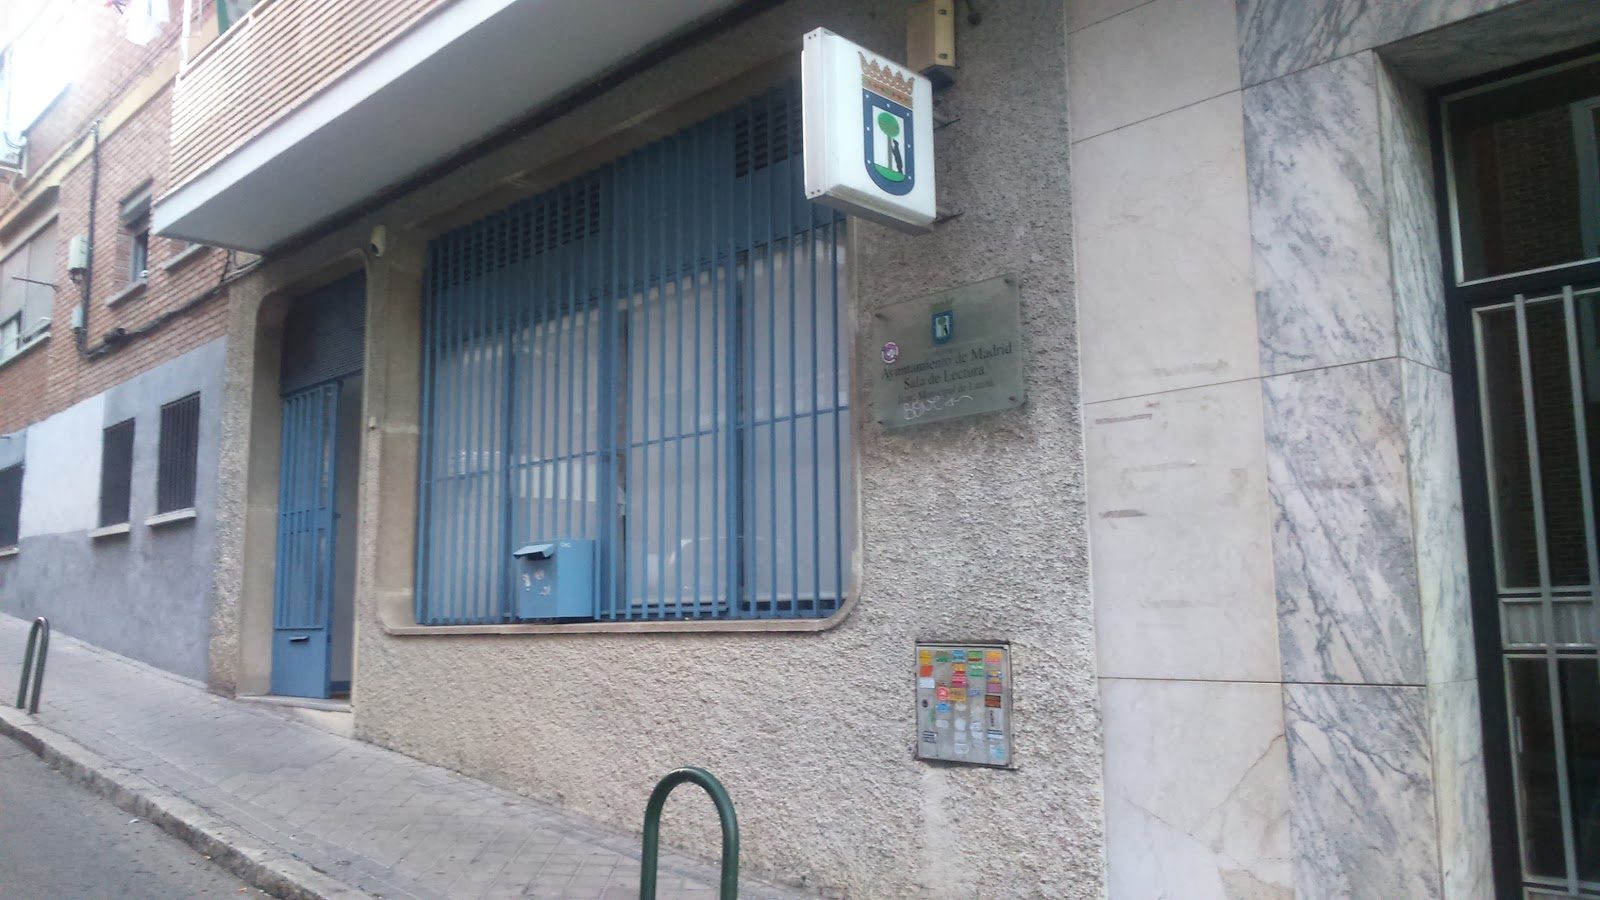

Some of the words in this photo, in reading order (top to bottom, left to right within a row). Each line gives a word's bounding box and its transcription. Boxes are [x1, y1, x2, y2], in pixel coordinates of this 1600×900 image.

[882, 357, 952, 380] Ayuntamiento
[954, 353, 968, 365] de
[971, 342, 1012, 360] Madrid
[903, 376, 926, 390] Sala
[928, 373, 941, 385] de
[944, 366, 985, 382] Lectura
